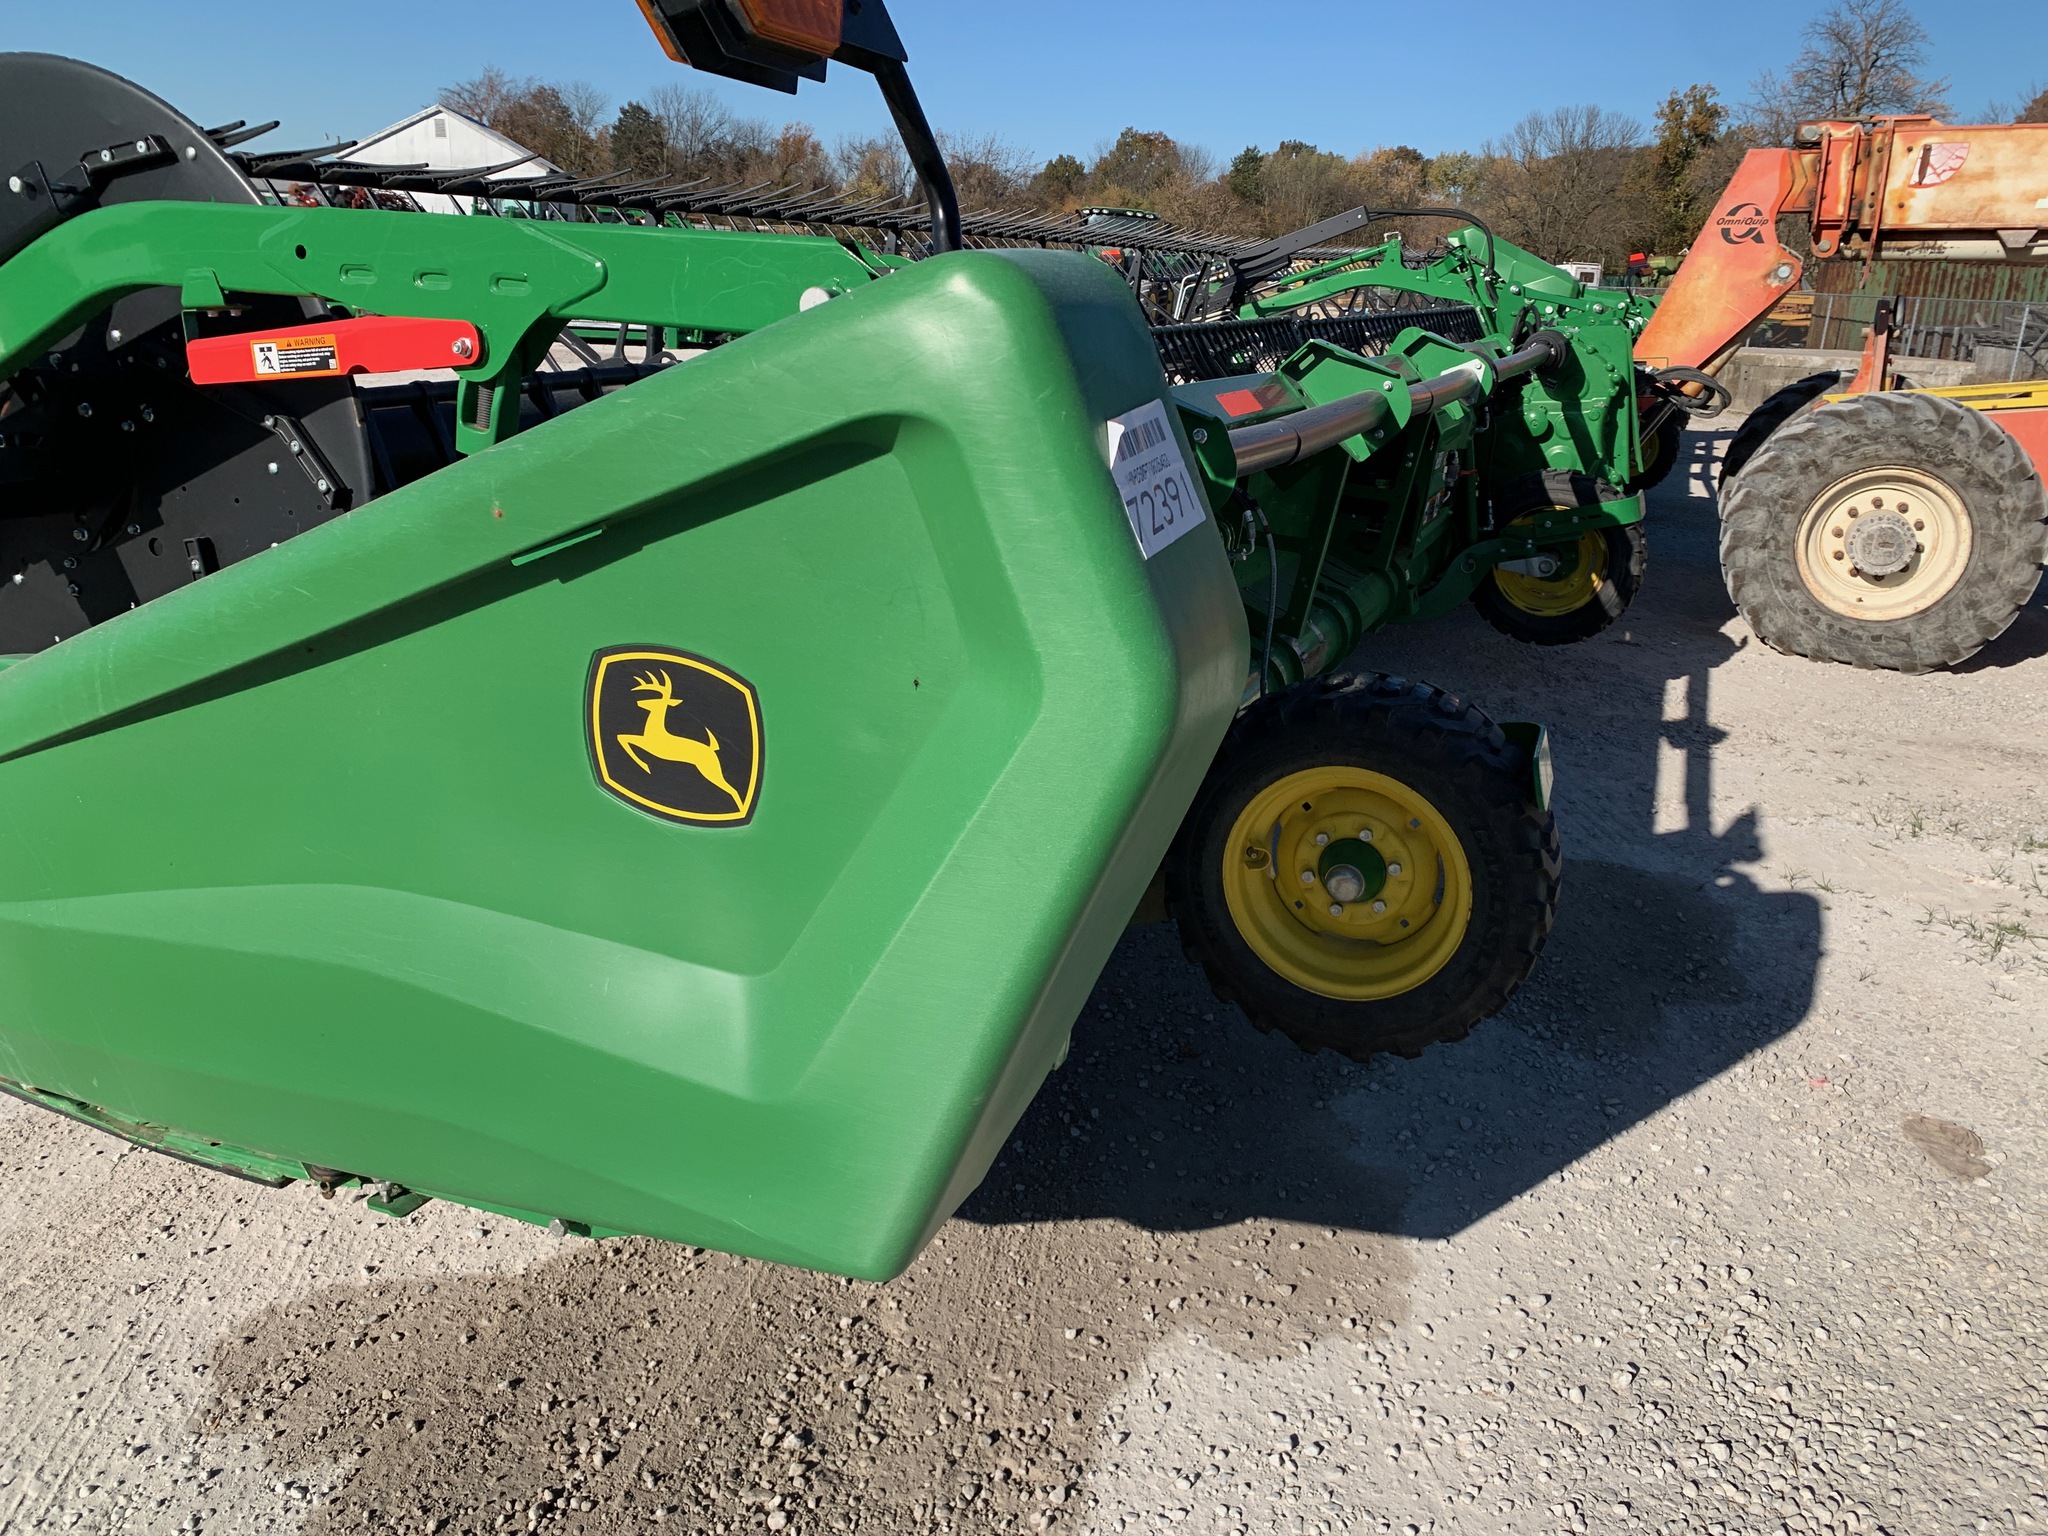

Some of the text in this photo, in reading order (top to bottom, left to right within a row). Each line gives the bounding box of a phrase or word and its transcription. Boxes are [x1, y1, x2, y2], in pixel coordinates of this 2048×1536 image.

[1716, 217, 1769, 226] OmniQuip
[294, 337, 325, 346] WARNING
[1126, 471, 1195, 544] 72391
